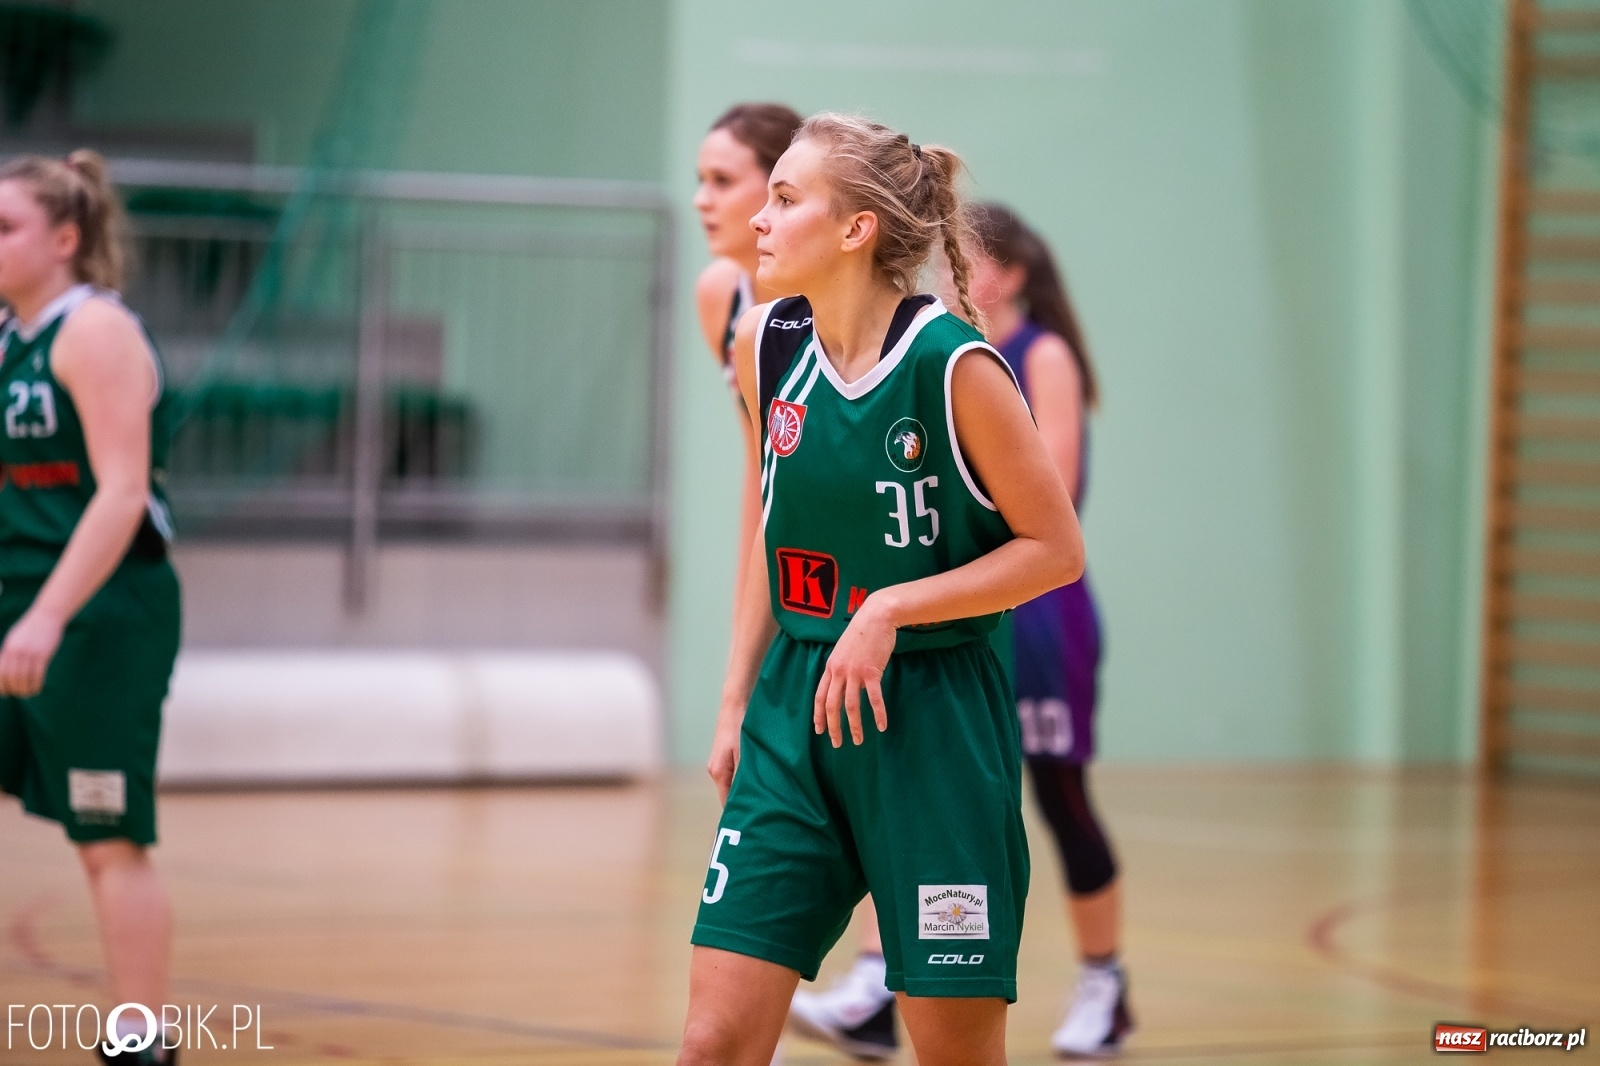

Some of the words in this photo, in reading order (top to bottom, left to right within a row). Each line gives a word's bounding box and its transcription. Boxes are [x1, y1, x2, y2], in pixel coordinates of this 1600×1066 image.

[769, 317, 813, 330] COLO
[5, 380, 58, 439] 23
[875, 475, 940, 548] 35
[781, 555, 830, 610] K
[924, 889, 984, 907] MoceNatury.pl
[924, 922, 955, 932] Marcin
[957, 922, 984, 933] Nykiel
[927, 954, 984, 965] COLO
